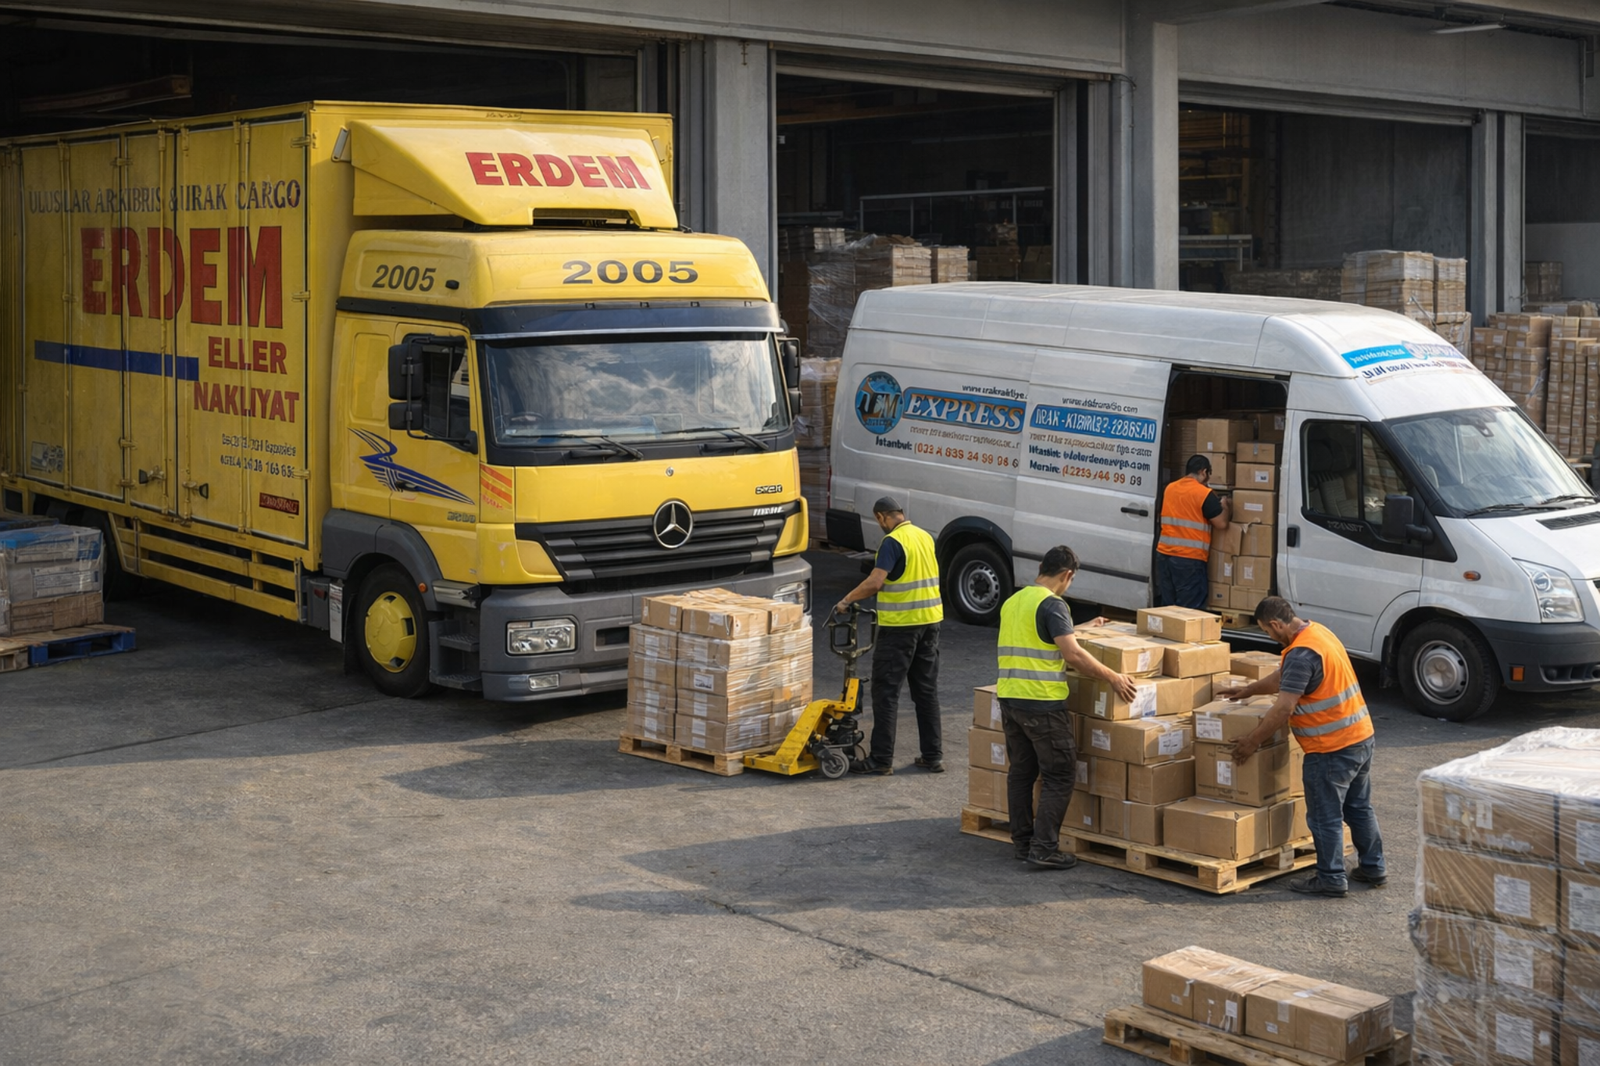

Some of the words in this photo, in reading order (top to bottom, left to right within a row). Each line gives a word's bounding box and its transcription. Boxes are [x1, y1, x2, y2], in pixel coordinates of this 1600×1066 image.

[465, 151, 652, 191] ERDEM
[236, 179, 301, 210] CARGO
[80, 225, 283, 329] ERDEM
[371, 264, 436, 292] 2005
[562, 260, 699, 284] 2005
[208, 336, 288, 375] ELLER
[904, 393, 1024, 431] EXPRESS
